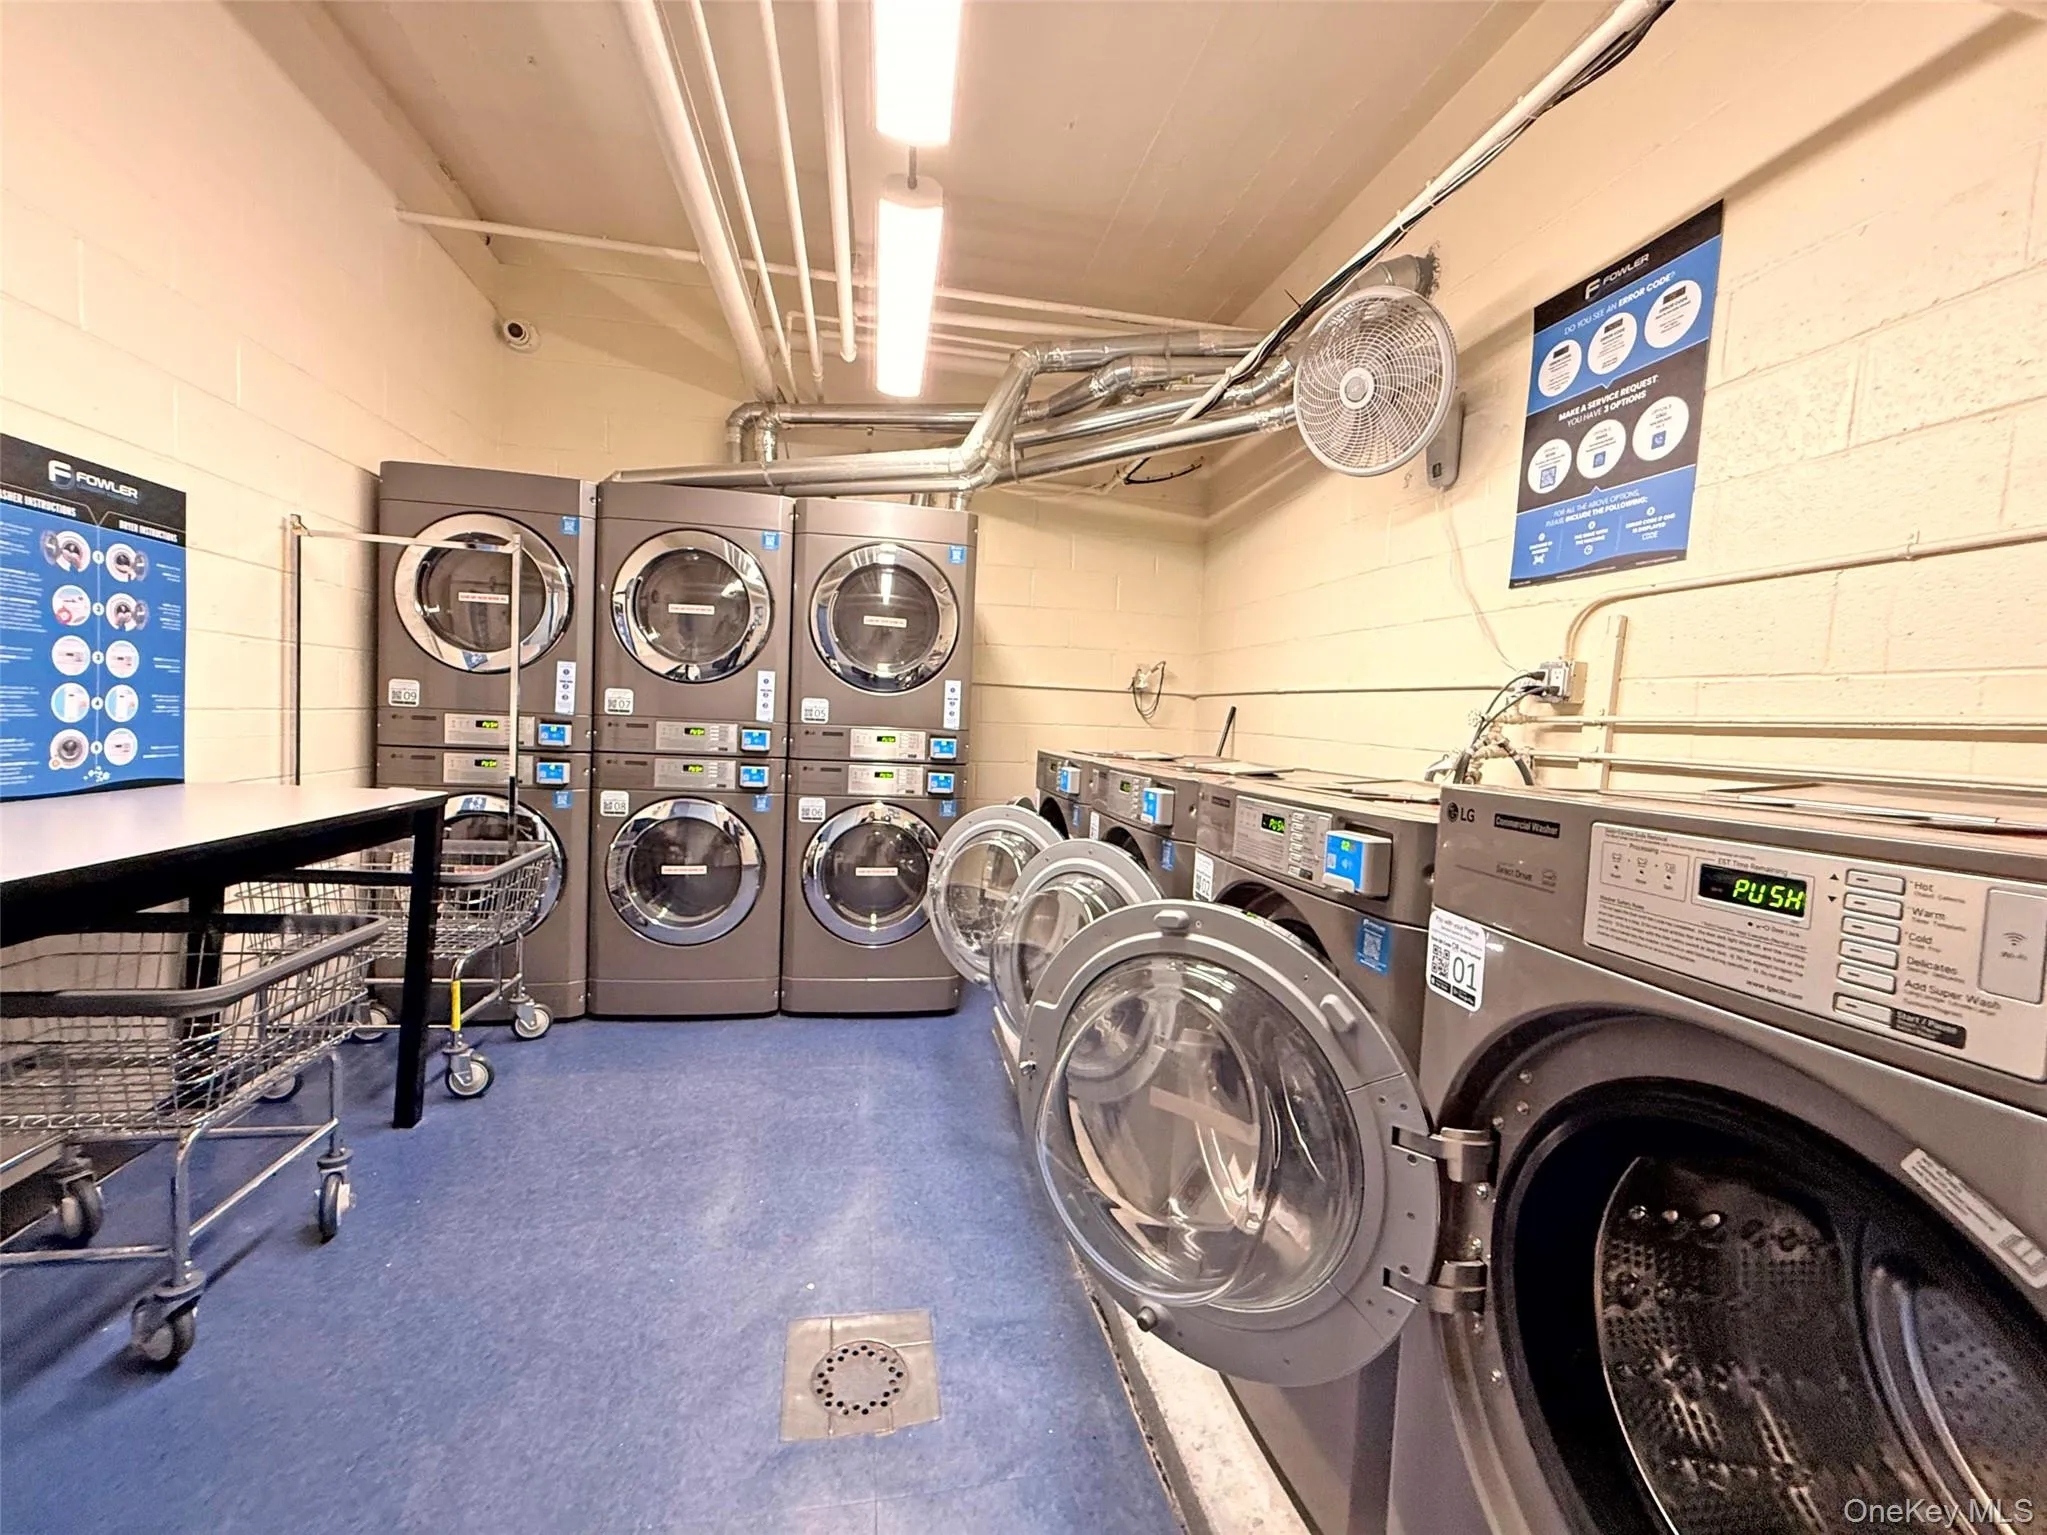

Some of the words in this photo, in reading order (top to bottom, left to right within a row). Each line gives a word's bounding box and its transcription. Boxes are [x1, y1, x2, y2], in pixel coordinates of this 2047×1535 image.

[1602, 253, 1650, 285] FOWLER
[1564, 324, 1576, 336] DO
[1577, 317, 1592, 329] YOU
[1591, 309, 1605, 321] SEE
[1605, 302, 1617, 314] AN
[1618, 288, 1645, 307] ERROR
[1558, 406, 1580, 421] MAKE
[1581, 403, 1587, 412] A
[1588, 391, 1619, 409] SERVICE
[1567, 415, 1582, 427] YOU
[1583, 408, 1601, 420] HAVE
[1610, 390, 1646, 411] OPTIONS
[76, 471, 138, 499] FOWLER
[403, 691, 417, 701] 09
[618, 701, 631, 709] 07
[814, 709, 827, 718] 05
[614, 802, 627, 811] 08
[811, 808, 823, 817] 06
[1460, 808, 1475, 823] LG
[1495, 816, 1531, 830] Commercial
[1532, 822, 1559, 835] Washer
[1717, 858, 1731, 867] EST
[1732, 859, 1749, 869] Time
[1750, 863, 1788, 877] Remaining
[1732, 879, 1806, 910] PUSH
[1914, 881, 1934, 893] Hot
[1912, 908, 1946, 920] Warm
[1908, 932, 1933, 945] Cold
[1452, 956, 1477, 992] 01
[1906, 956, 1958, 975] Delicates
[1904, 979, 1926, 992] Add
[1928, 985, 1964, 1001] Super
[1966, 994, 2002, 1010] Wash
[1896, 1011, 1920, 1023] Start
